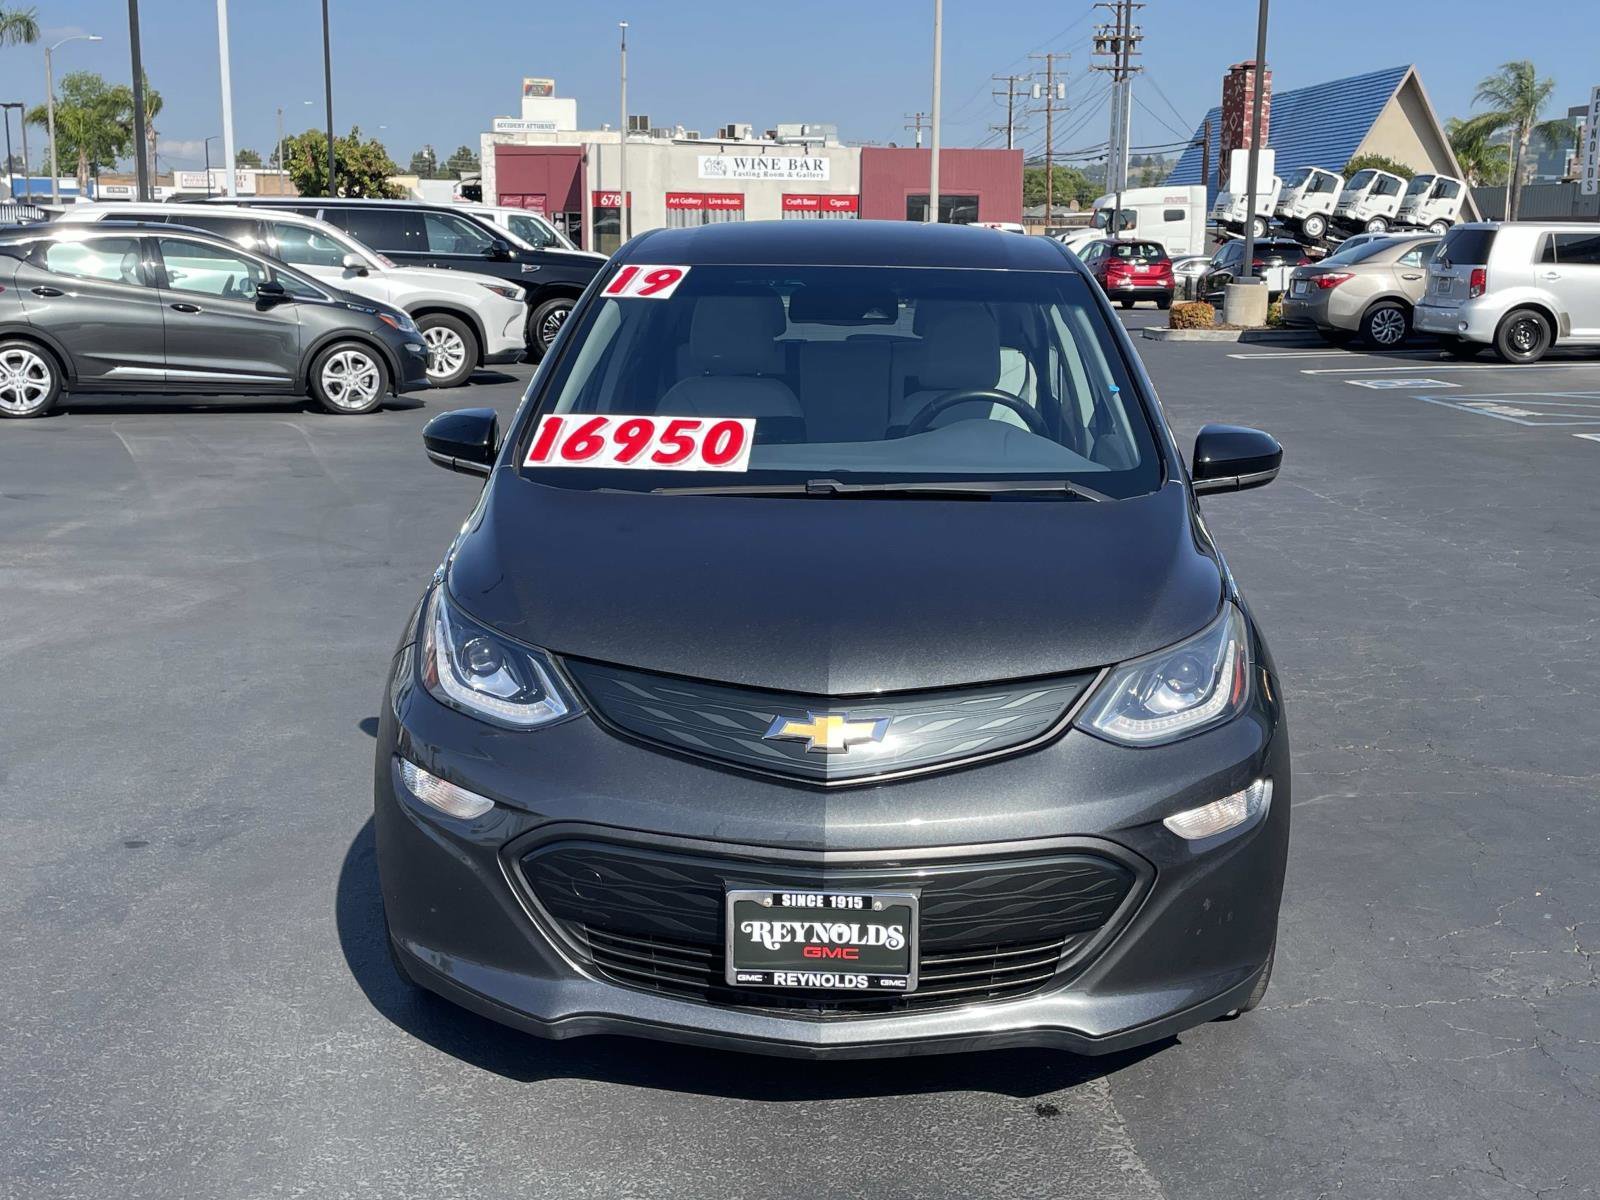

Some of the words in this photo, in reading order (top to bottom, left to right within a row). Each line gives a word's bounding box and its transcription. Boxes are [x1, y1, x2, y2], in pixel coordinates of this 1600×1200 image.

[734, 157, 781, 171] WINE
[789, 158, 824, 171] BAR
[796, 171, 824, 179] Gallery
[601, 194, 622, 206] 678
[680, 197, 702, 206] Gallery
[785, 198, 802, 206] Craft
[830, 199, 850, 208] Cigars
[607, 266, 683, 296] 19
[528, 416, 747, 467] 16950
[781, 894, 824, 908] SINCE
[829, 895, 863, 909] 1915
[740, 921, 905, 951] REYNOLDS
[803, 946, 860, 960] GMC
[737, 974, 763, 982] GMC
[773, 973, 869, 988] REYNOLDS
[880, 979, 907, 987] GMC
